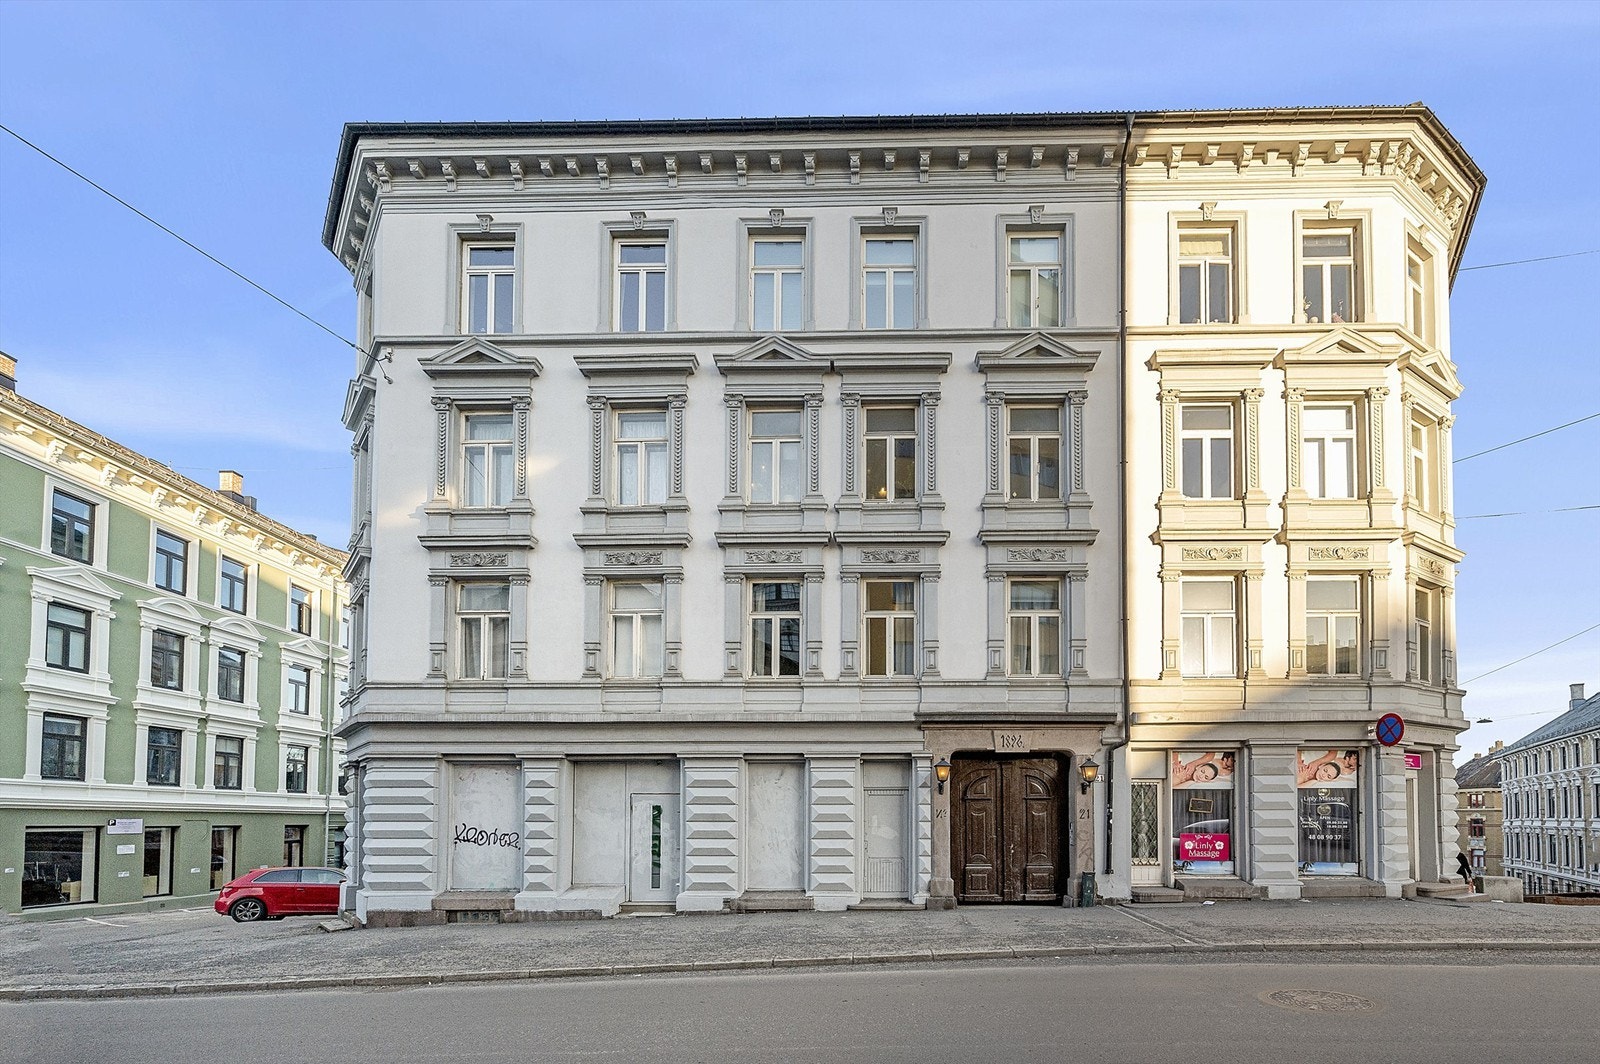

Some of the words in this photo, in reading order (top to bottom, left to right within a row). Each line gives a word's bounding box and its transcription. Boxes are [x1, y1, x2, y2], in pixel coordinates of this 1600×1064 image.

[1079, 808, 1090, 819] 21
[1195, 841, 1214, 851] Linly
[1188, 850, 1220, 859] Massage
